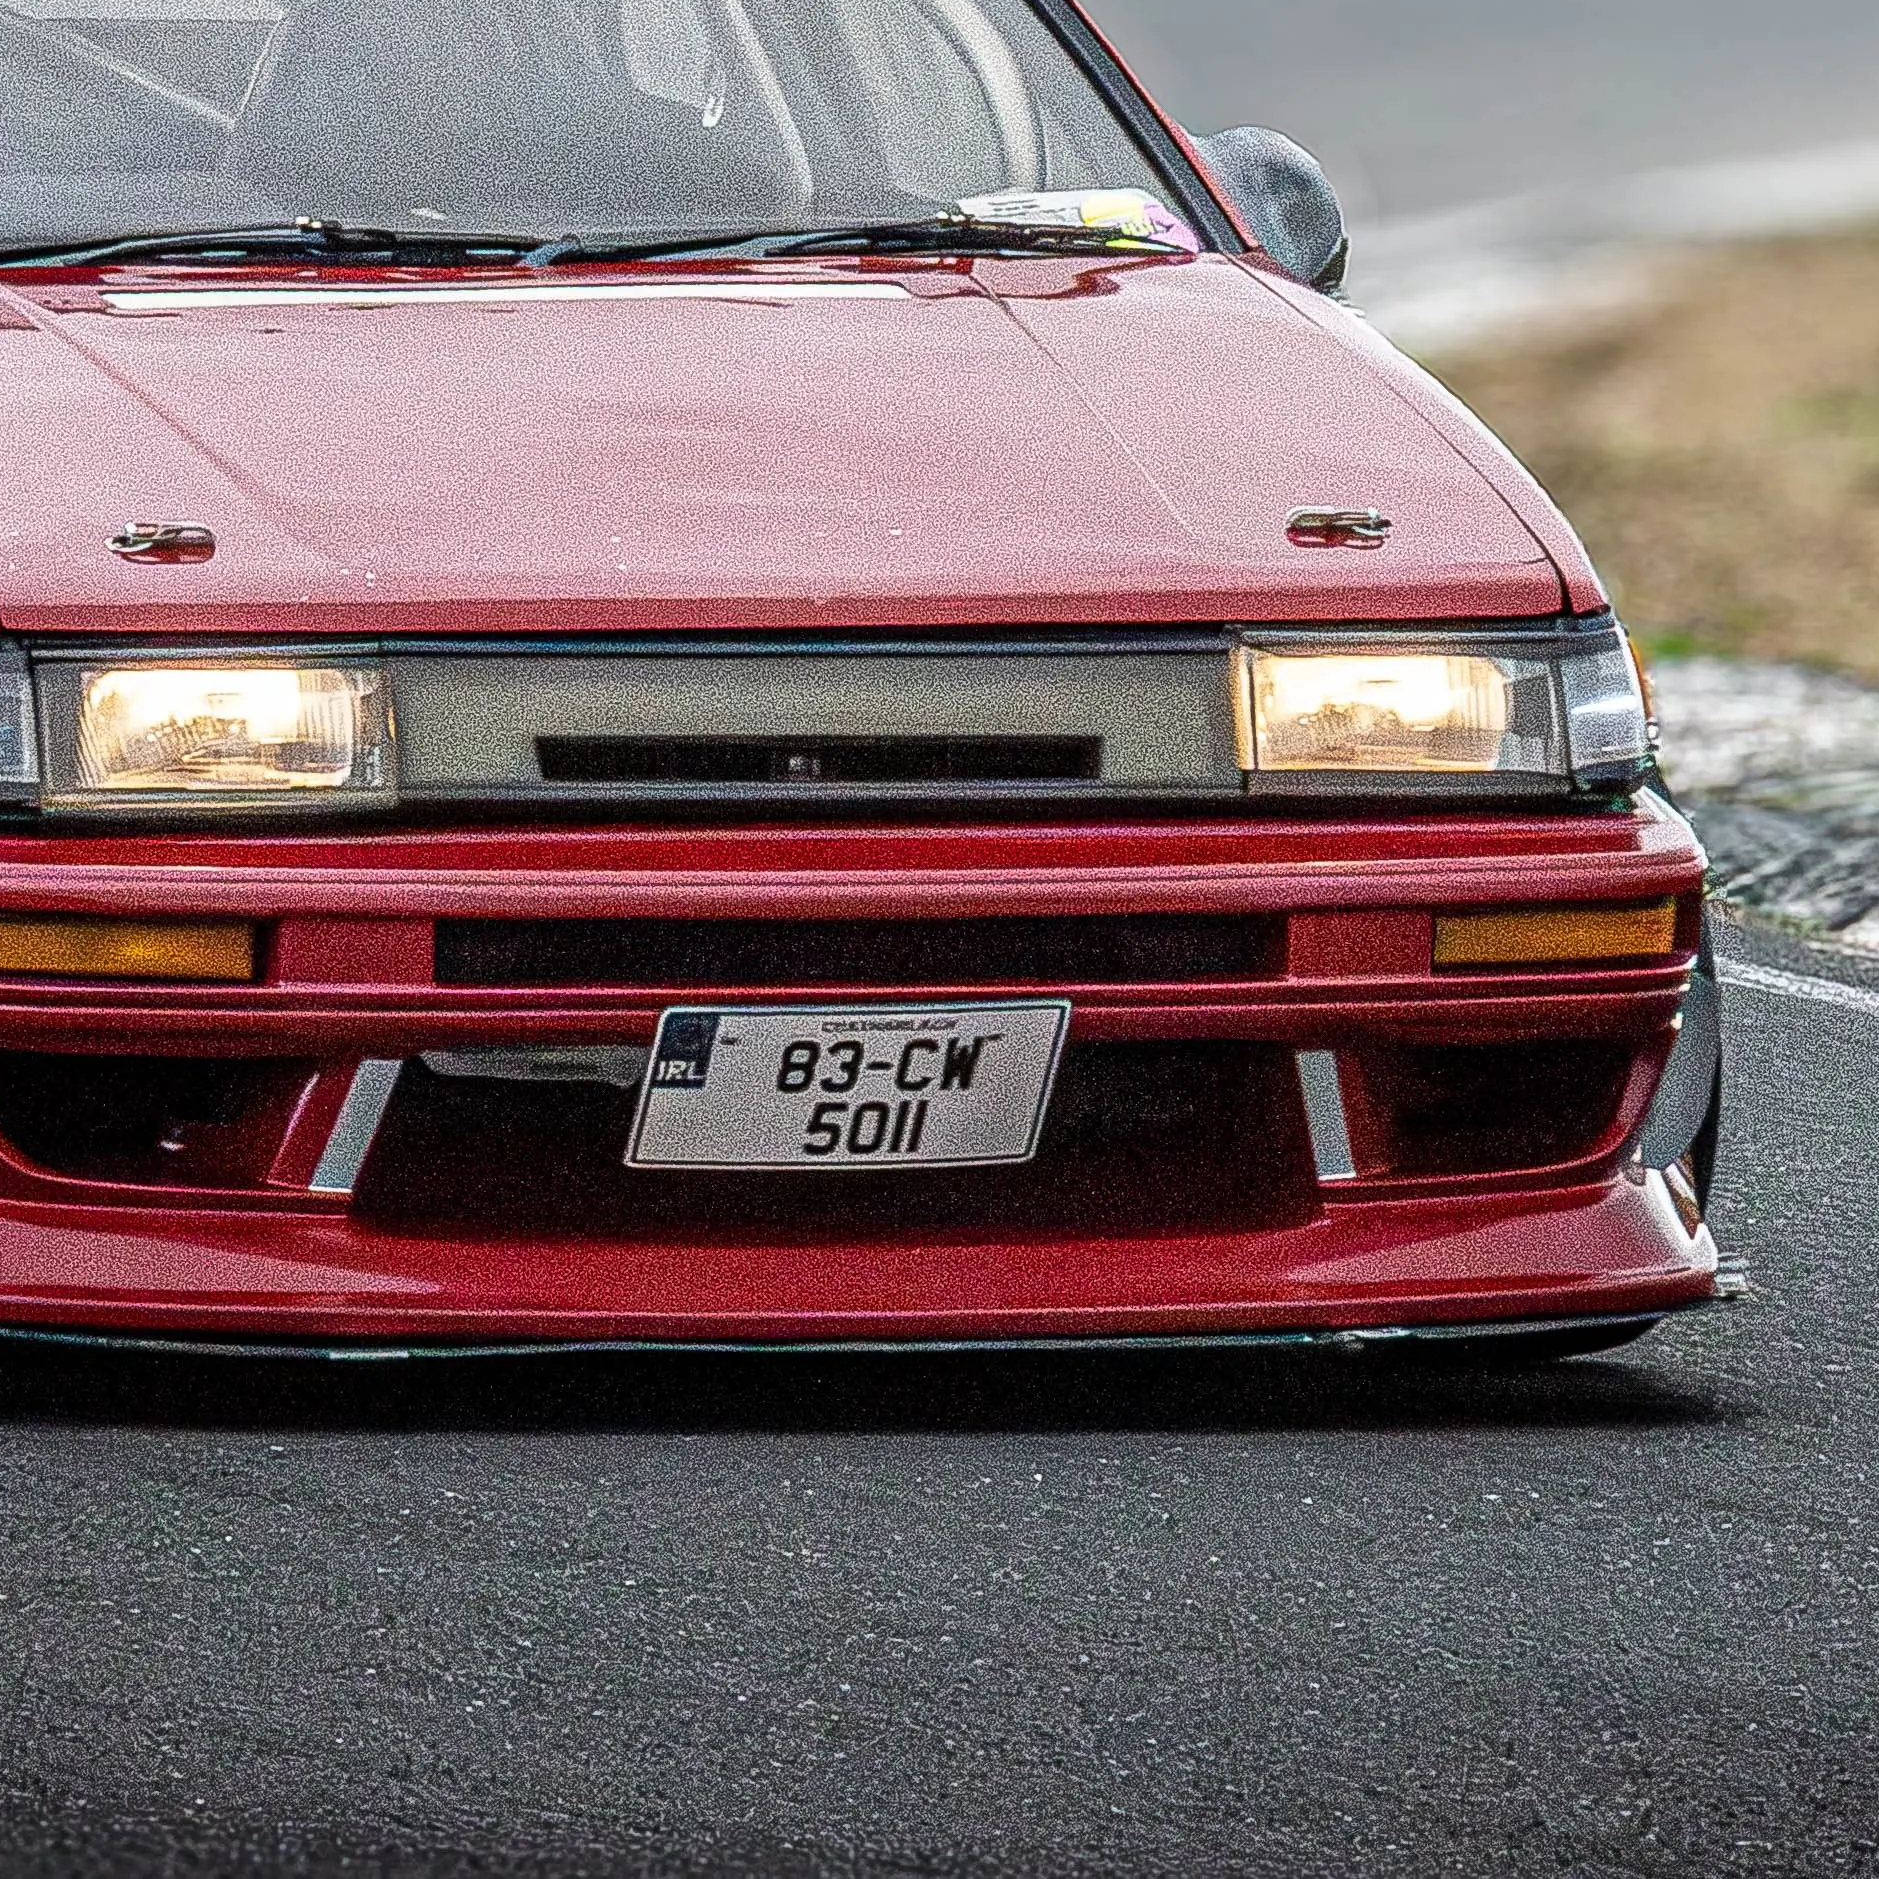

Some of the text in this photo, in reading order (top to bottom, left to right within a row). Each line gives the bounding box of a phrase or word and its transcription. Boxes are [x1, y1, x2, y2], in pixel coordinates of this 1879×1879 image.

[658, 1060, 706, 1081] IRL
[776, 1037, 984, 1094] 83-CW
[802, 1099, 929, 1156] 5011
